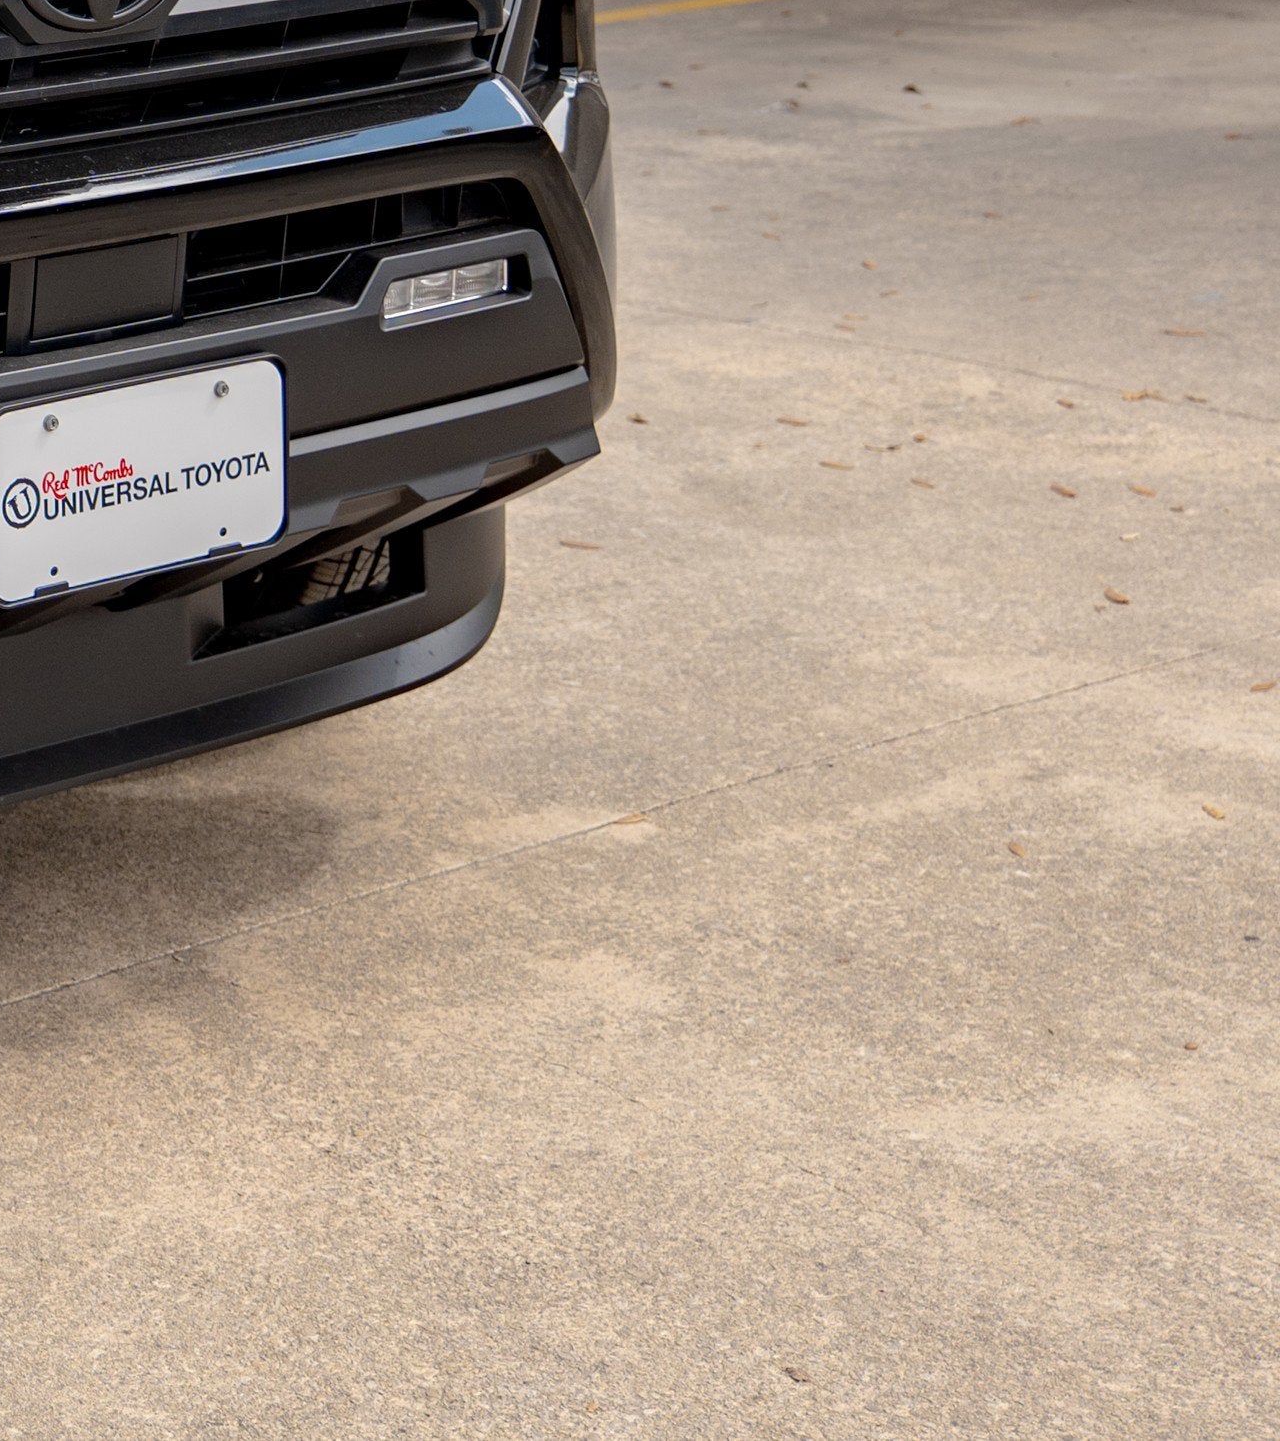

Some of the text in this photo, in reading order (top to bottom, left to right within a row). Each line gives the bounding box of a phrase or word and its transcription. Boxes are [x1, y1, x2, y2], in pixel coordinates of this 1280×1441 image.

[42, 458, 133, 499] Red McCombs
[44, 452, 270, 520] UNIVERSAL TOYOTA
